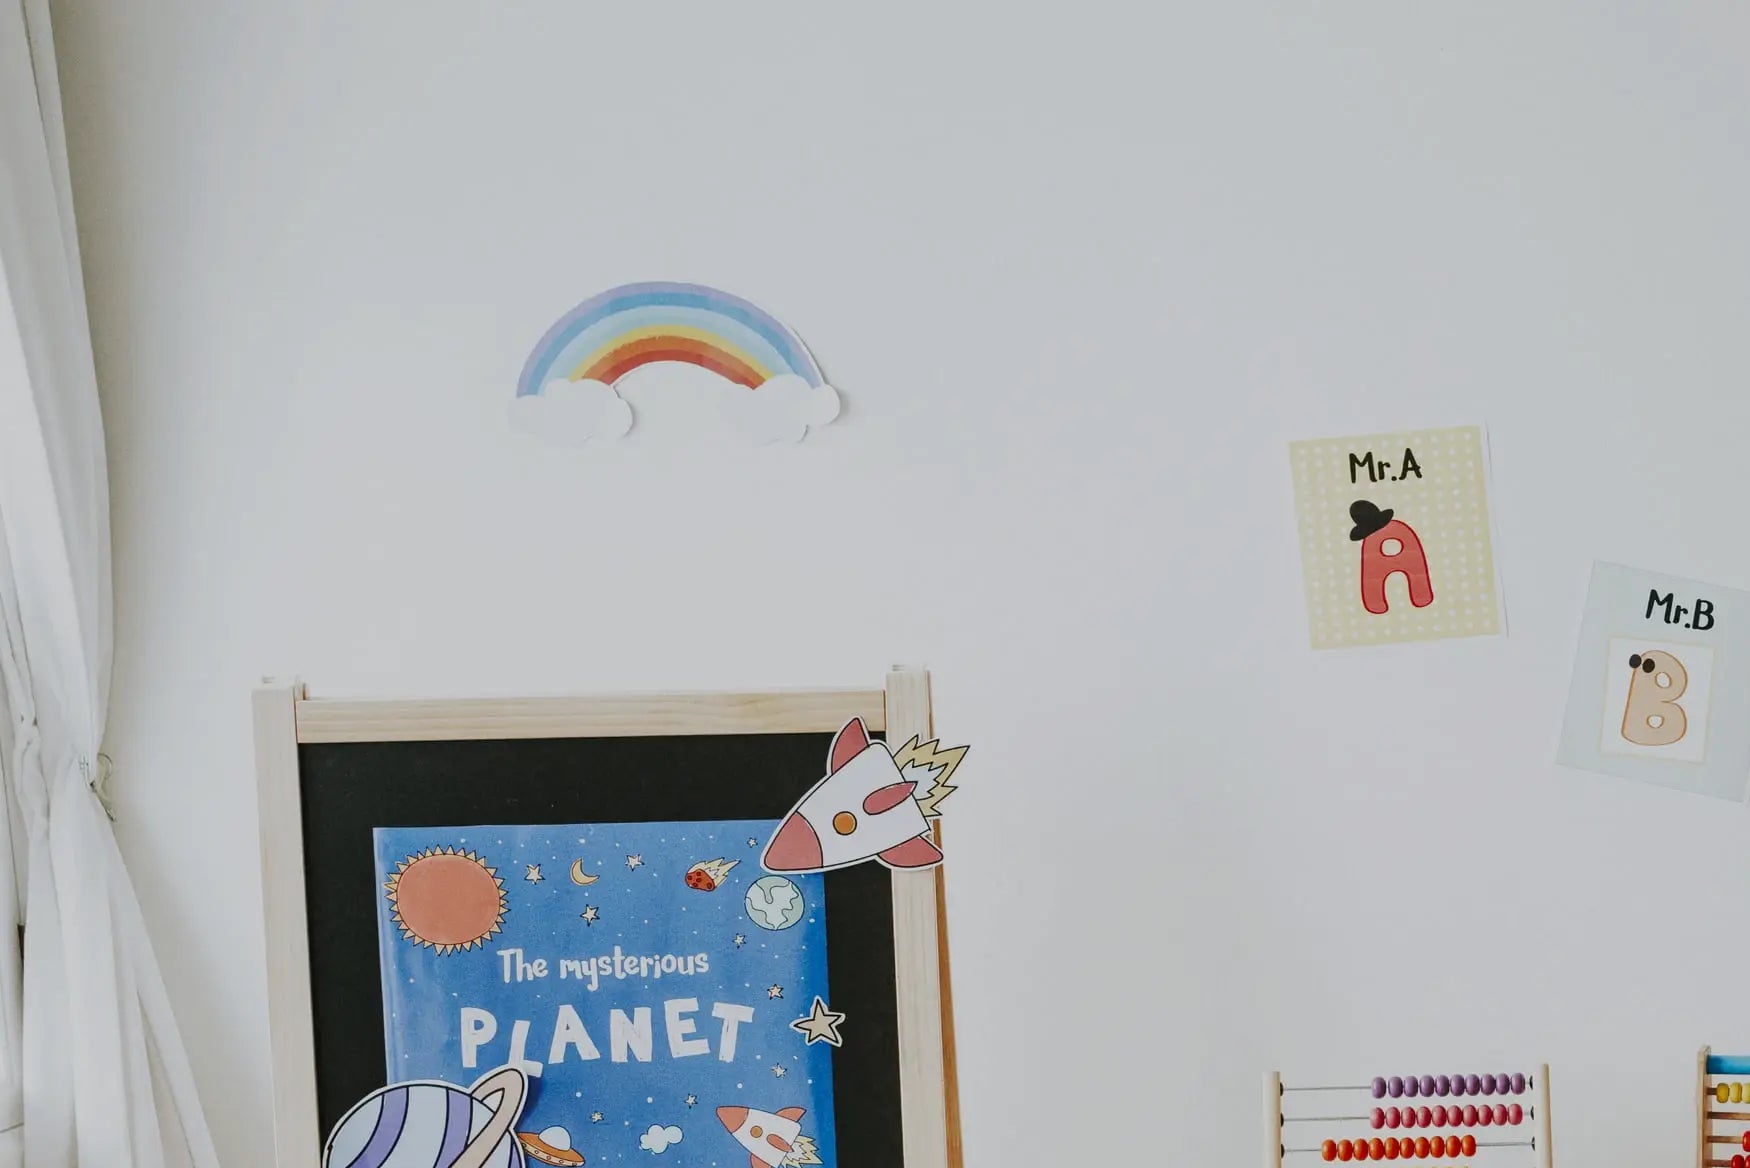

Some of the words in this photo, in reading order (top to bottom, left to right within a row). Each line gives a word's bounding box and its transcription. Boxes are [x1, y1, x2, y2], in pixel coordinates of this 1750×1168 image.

[1349, 447, 1423, 484] Mr.A
[1360, 519, 1434, 614] A
[1646, 588, 1715, 631] Mr.B
[1620, 649, 1689, 747] B
[497, 947, 548, 984] The
[559, 946, 709, 991] mysterious
[460, 996, 754, 1077] PLANET
